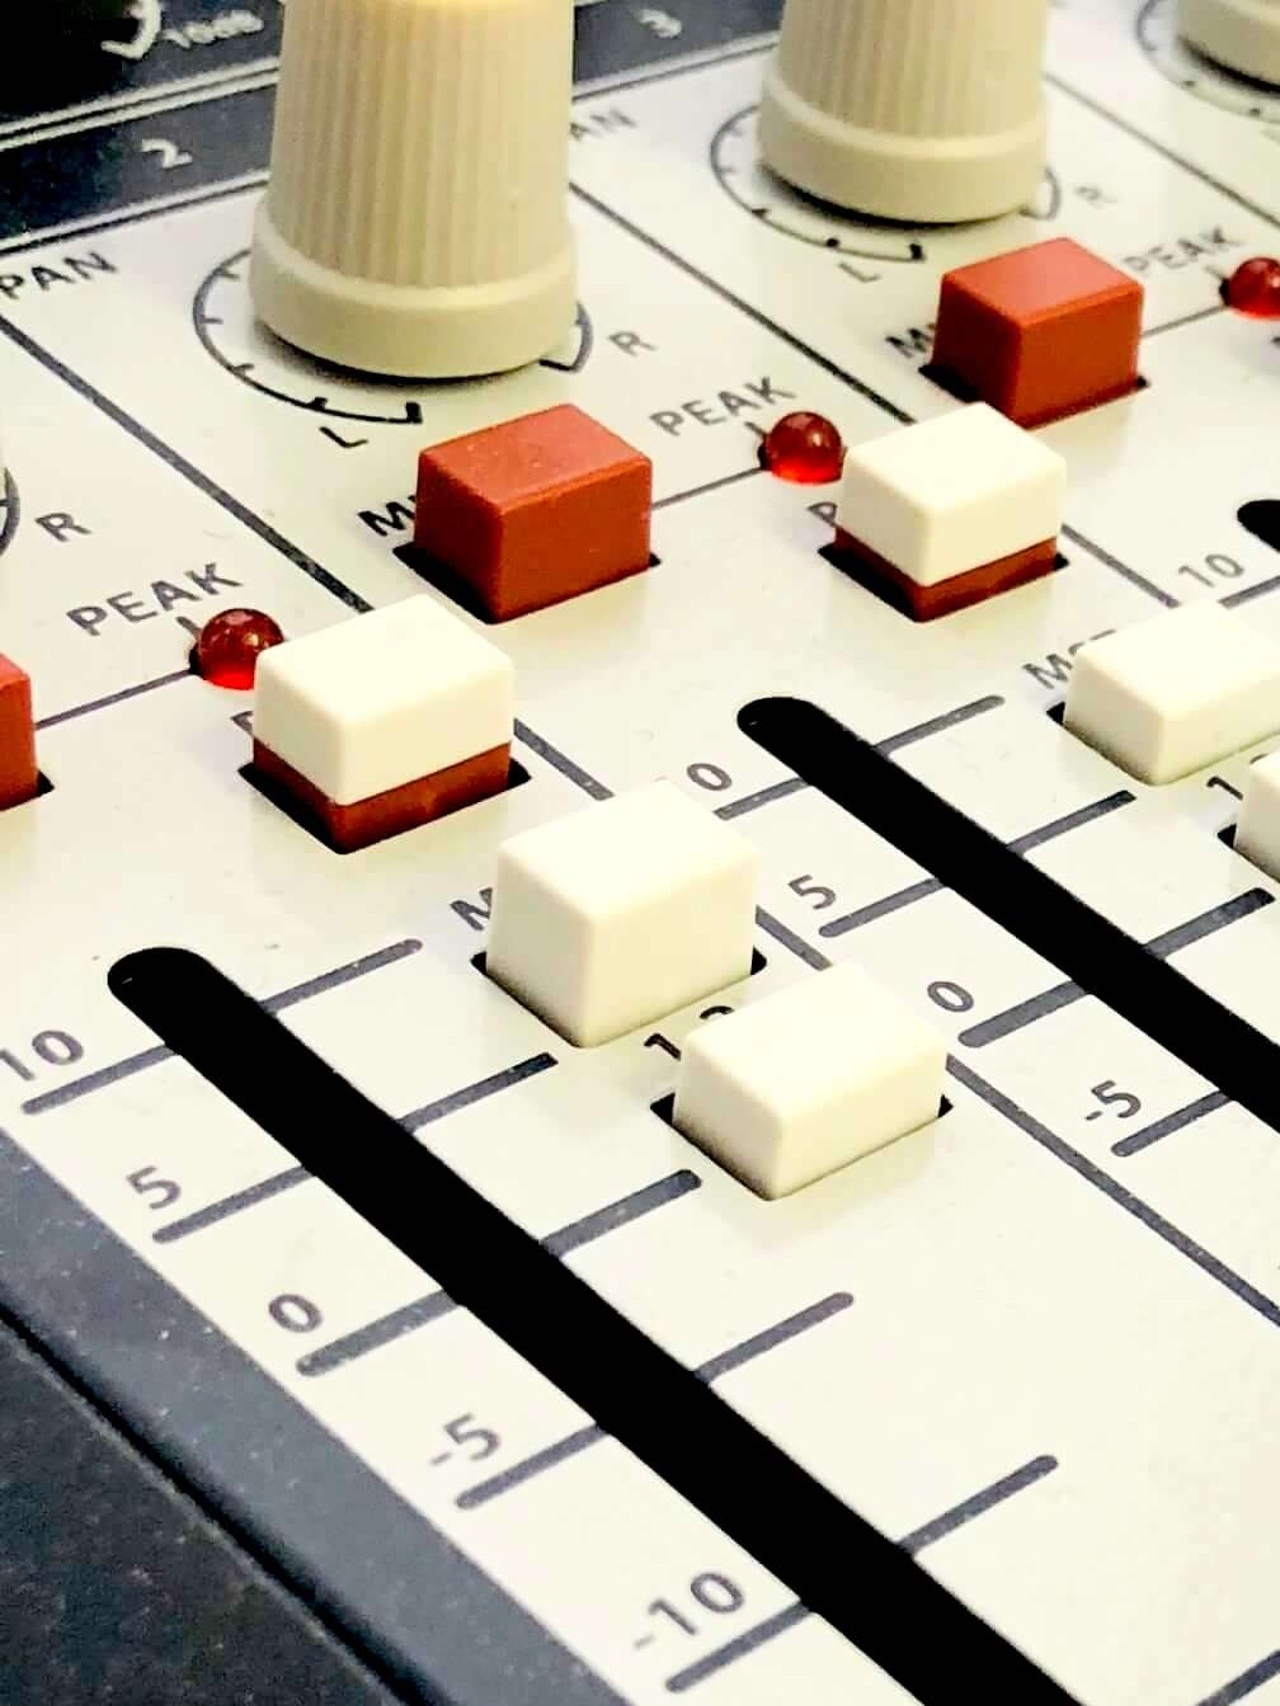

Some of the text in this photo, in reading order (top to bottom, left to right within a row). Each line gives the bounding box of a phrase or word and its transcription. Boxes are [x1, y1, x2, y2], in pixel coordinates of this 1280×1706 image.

[140, 139, 193, 169] 2
[0, 250, 117, 293] PAN
[1124, 226, 1241, 274] PEAK
[608, 329, 658, 359] R
[648, 375, 796, 438] PEAK
[320, 425, 369, 449] L
[35, 512, 92, 543] R
[1177, 553, 1245, 588] 10
[65, 561, 243, 637] PEAK
[788, 873, 838, 909] 5
[927, 980, 974, 1013] 0
[0, 1029, 84, 1081] 10
[1085, 1079, 1141, 1124] -5
[126, 1166, 182, 1210] 5
[267, 1294, 324, 1333] 0
[427, 1412, 501, 1463] -5
[632, 1572, 744, 1646] -10
